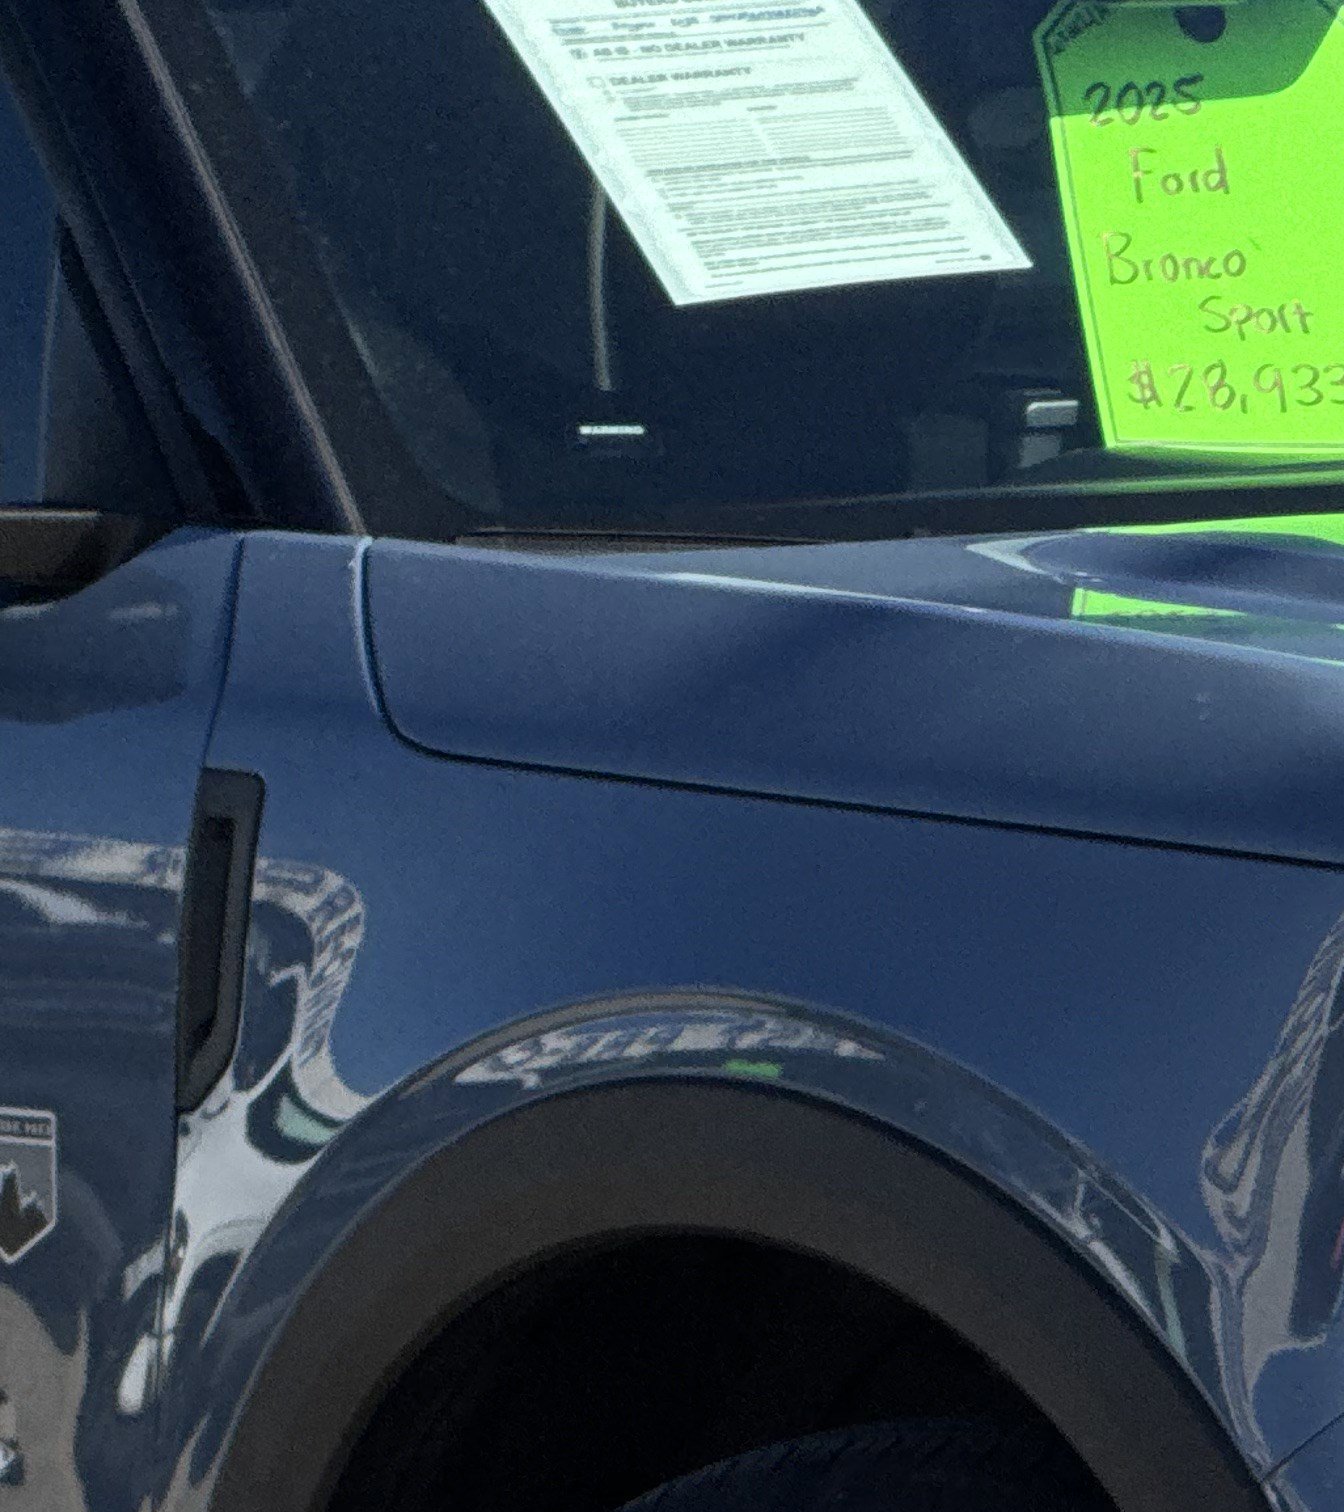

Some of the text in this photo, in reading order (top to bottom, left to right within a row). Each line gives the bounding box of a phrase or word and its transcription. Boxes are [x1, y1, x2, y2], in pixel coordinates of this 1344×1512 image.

[664, 40, 722, 51] DEALER
[724, 32, 804, 47] WARRANTY
[609, 66, 751, 86] DEALER WARRANTY
[1084, 73, 1205, 127] 2025
[1128, 144, 1230, 204] Ford
[1101, 230, 1247, 286] Bronco
[1198, 295, 1314, 341] Sport
